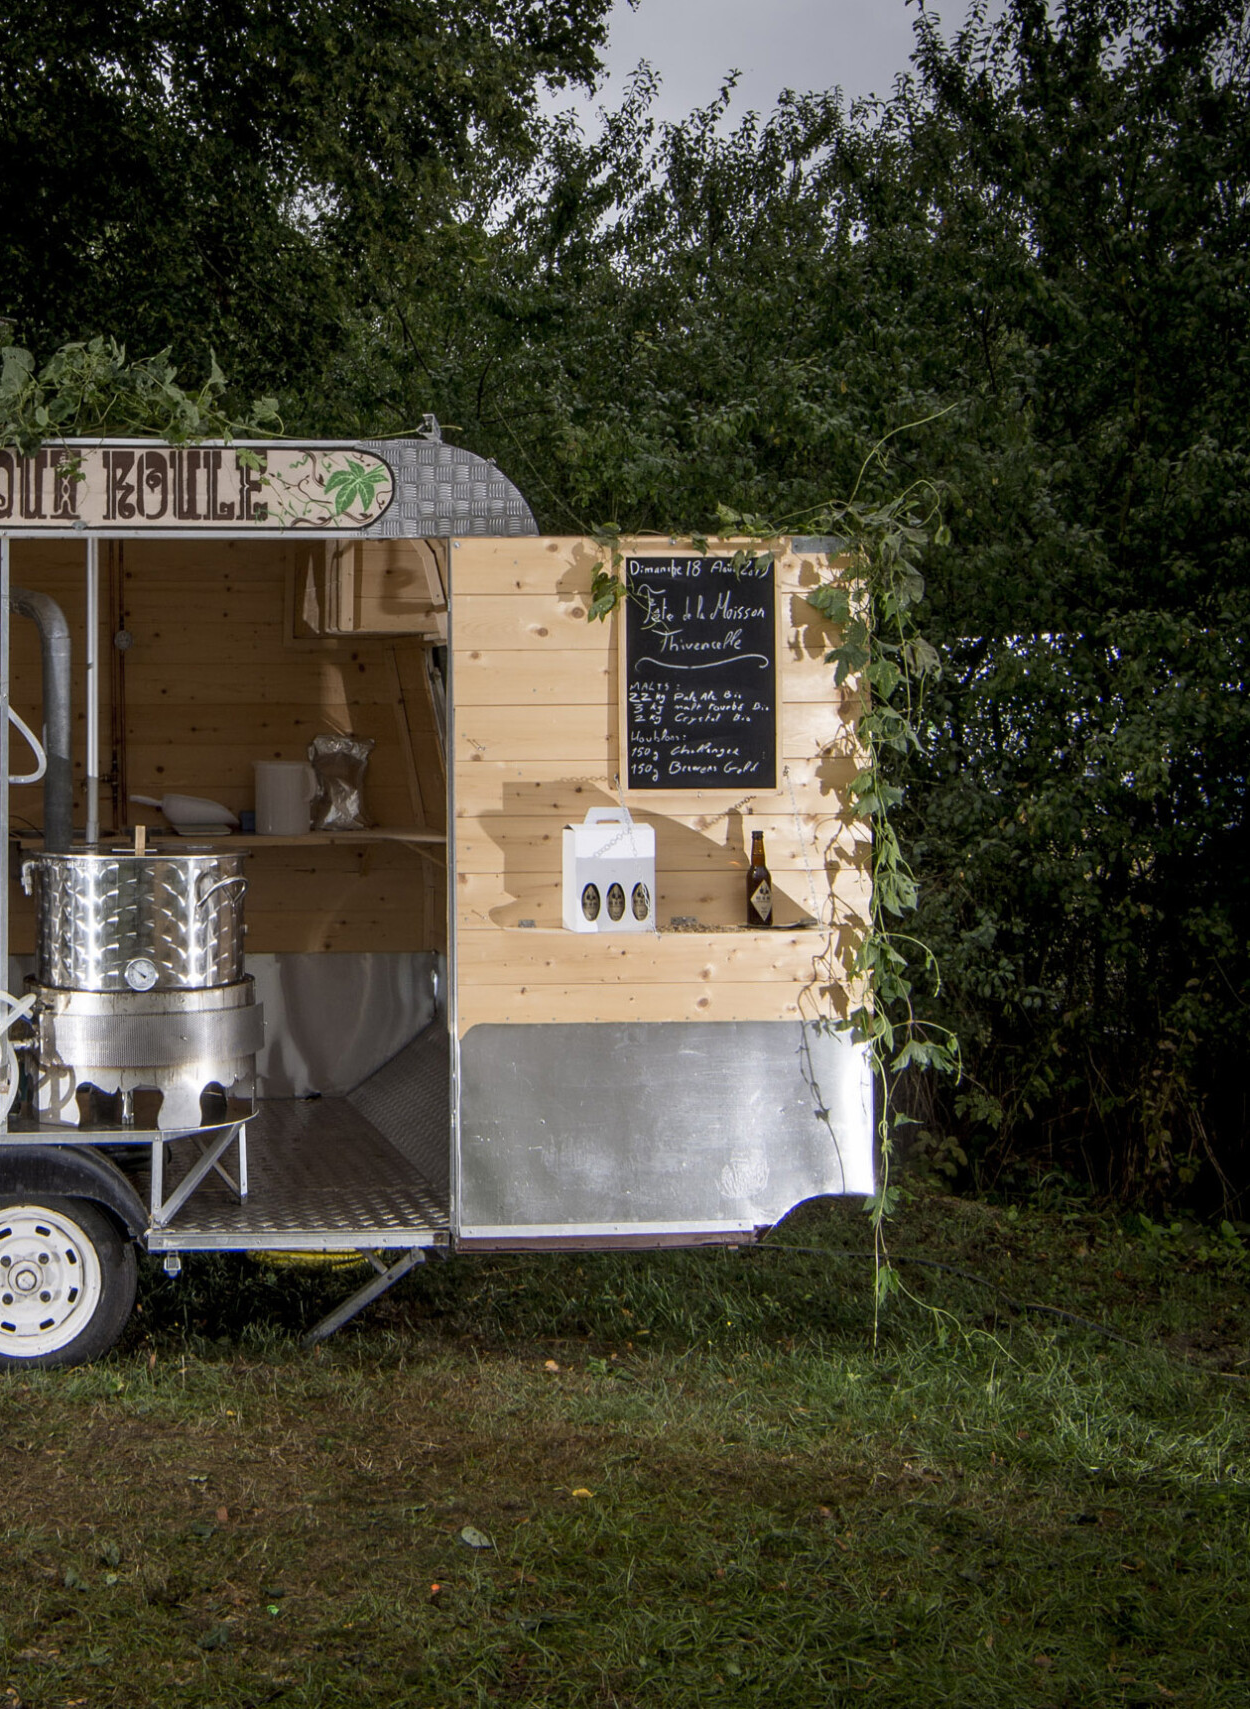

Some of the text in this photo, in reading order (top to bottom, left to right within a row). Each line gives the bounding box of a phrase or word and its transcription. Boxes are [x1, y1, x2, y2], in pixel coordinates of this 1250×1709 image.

[102, 449, 269, 521] ROULE
[630, 559, 683, 578] Dimanche
[686, 560, 702, 577] 18
[710, 560, 739, 574] Aoû
[637, 583, 765, 624] Fête de la Moisson
[651, 628, 743, 653] Thivencelle
[629, 681, 670, 691] MALTS
[629, 692, 652, 702] 22
[700, 690, 718, 700] Ale
[633, 703, 644, 714] 3
[634, 714, 646, 722] 2
[674, 712, 721, 725] Crystal
